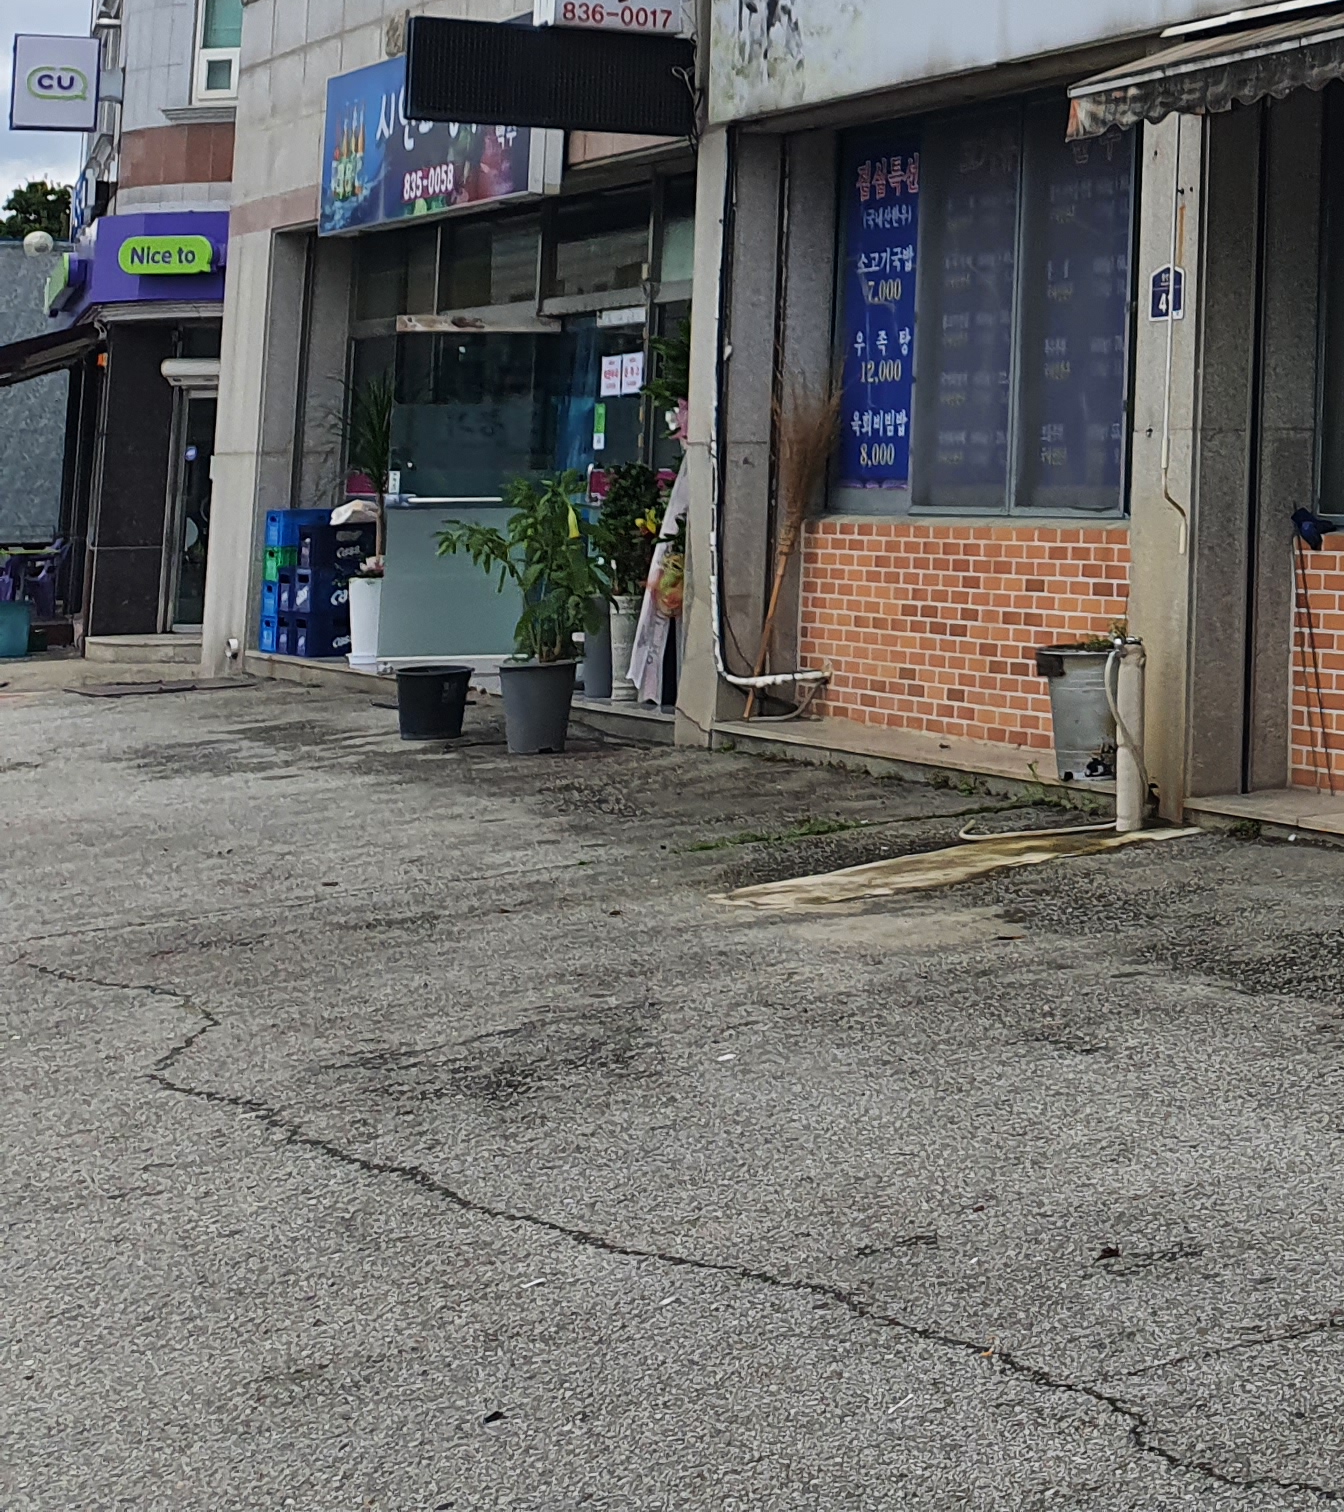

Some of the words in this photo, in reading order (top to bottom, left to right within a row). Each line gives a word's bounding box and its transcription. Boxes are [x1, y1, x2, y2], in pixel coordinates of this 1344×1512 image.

[562, 1, 673, 29] 836-0017
[37, 73, 75, 90] CU
[403, 163, 454, 200] 835-0058
[130, 245, 172, 266] Nice
[177, 245, 196, 265] to
[856, 244, 914, 274] 소고기국밥
[860, 359, 902, 385] 12,000
[851, 408, 909, 437] 육회비빔밥
[859, 442, 895, 468] 8,000
